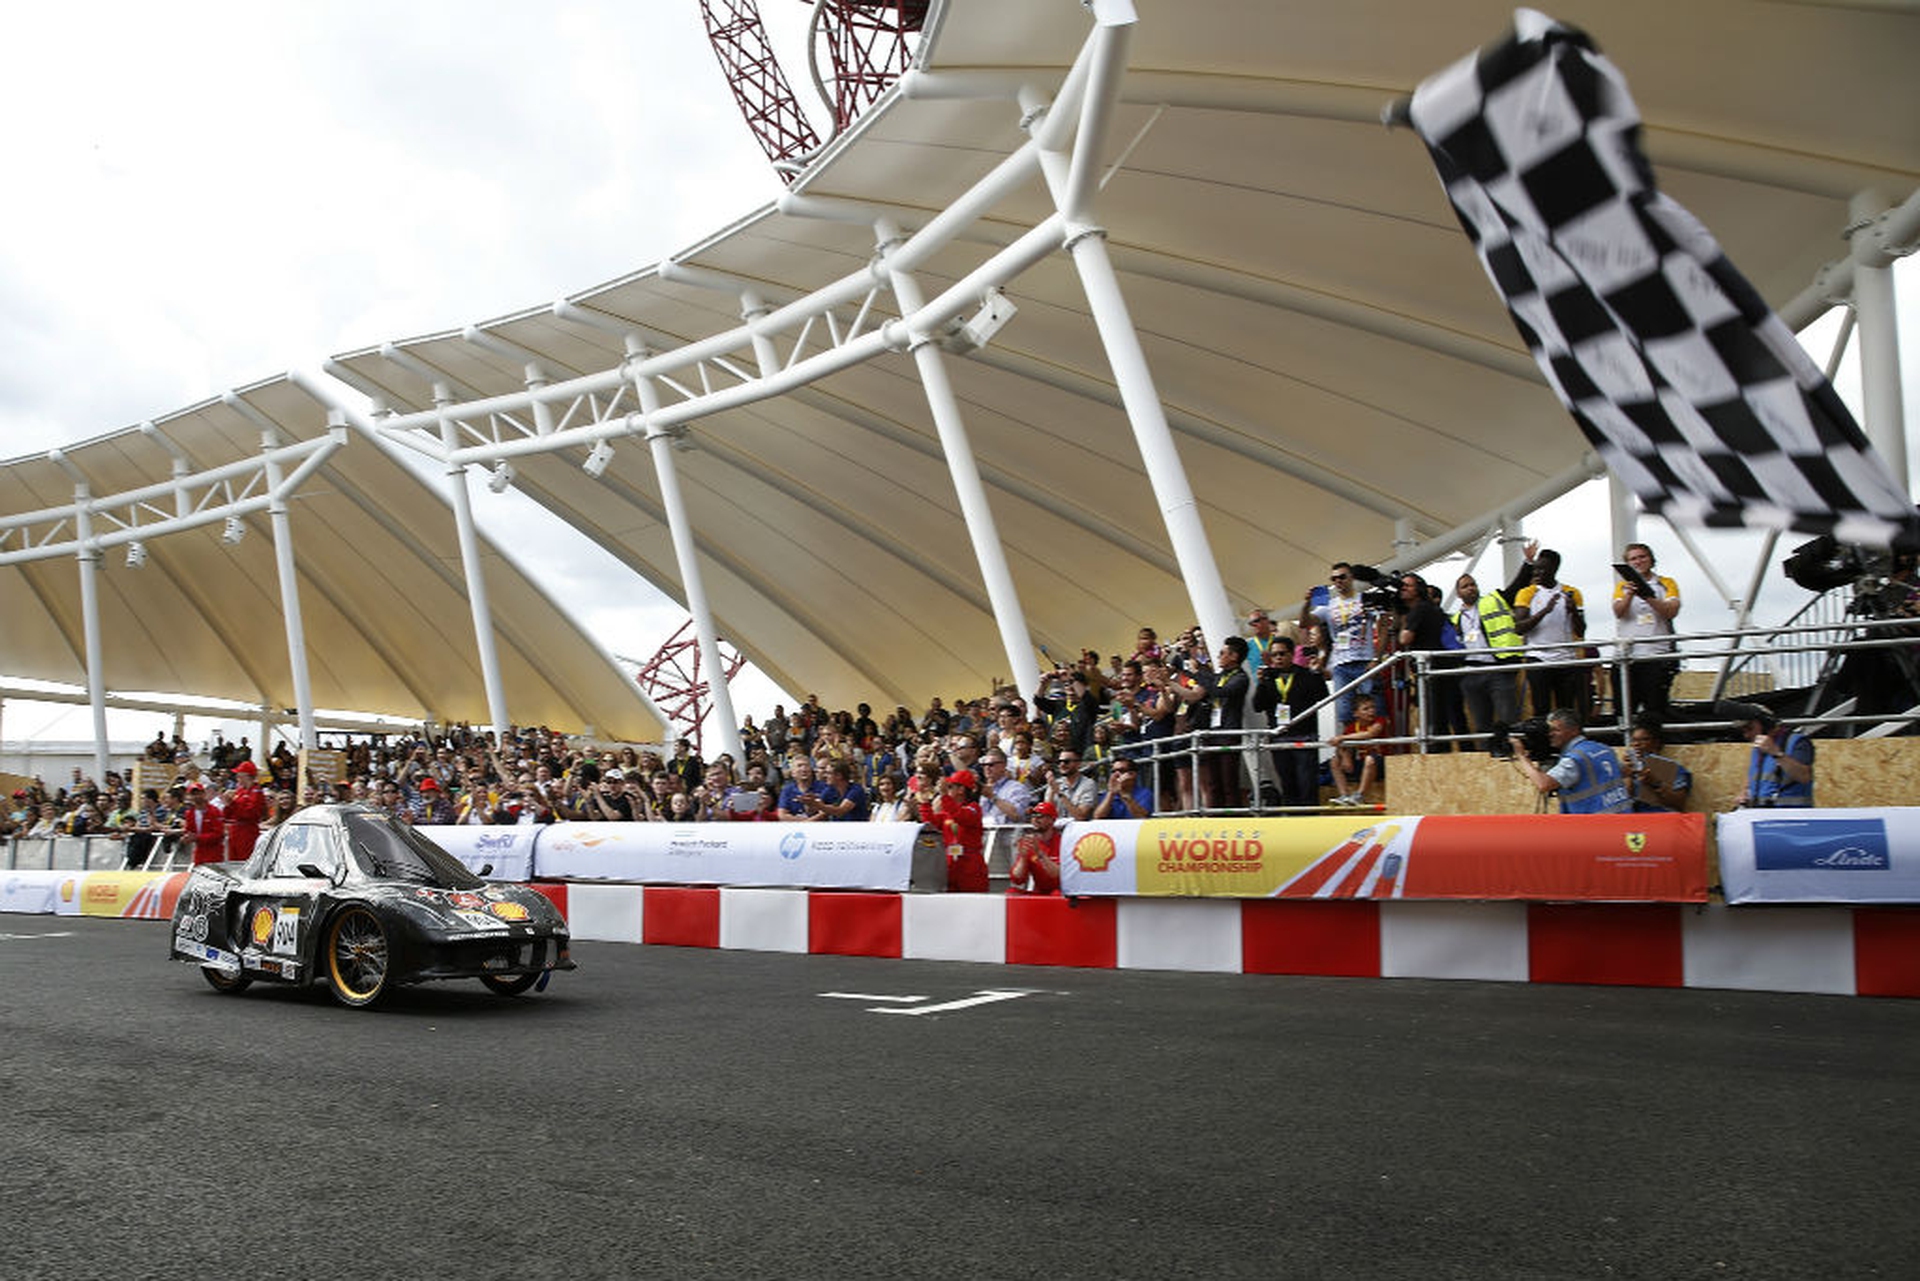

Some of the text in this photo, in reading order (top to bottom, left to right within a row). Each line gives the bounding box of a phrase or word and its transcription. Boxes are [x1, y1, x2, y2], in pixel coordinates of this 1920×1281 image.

[1159, 840, 1263, 861] WORLD
[1815, 847, 1883, 866] Linde
[1157, 862, 1263, 874] CHAMPIONSHIP
